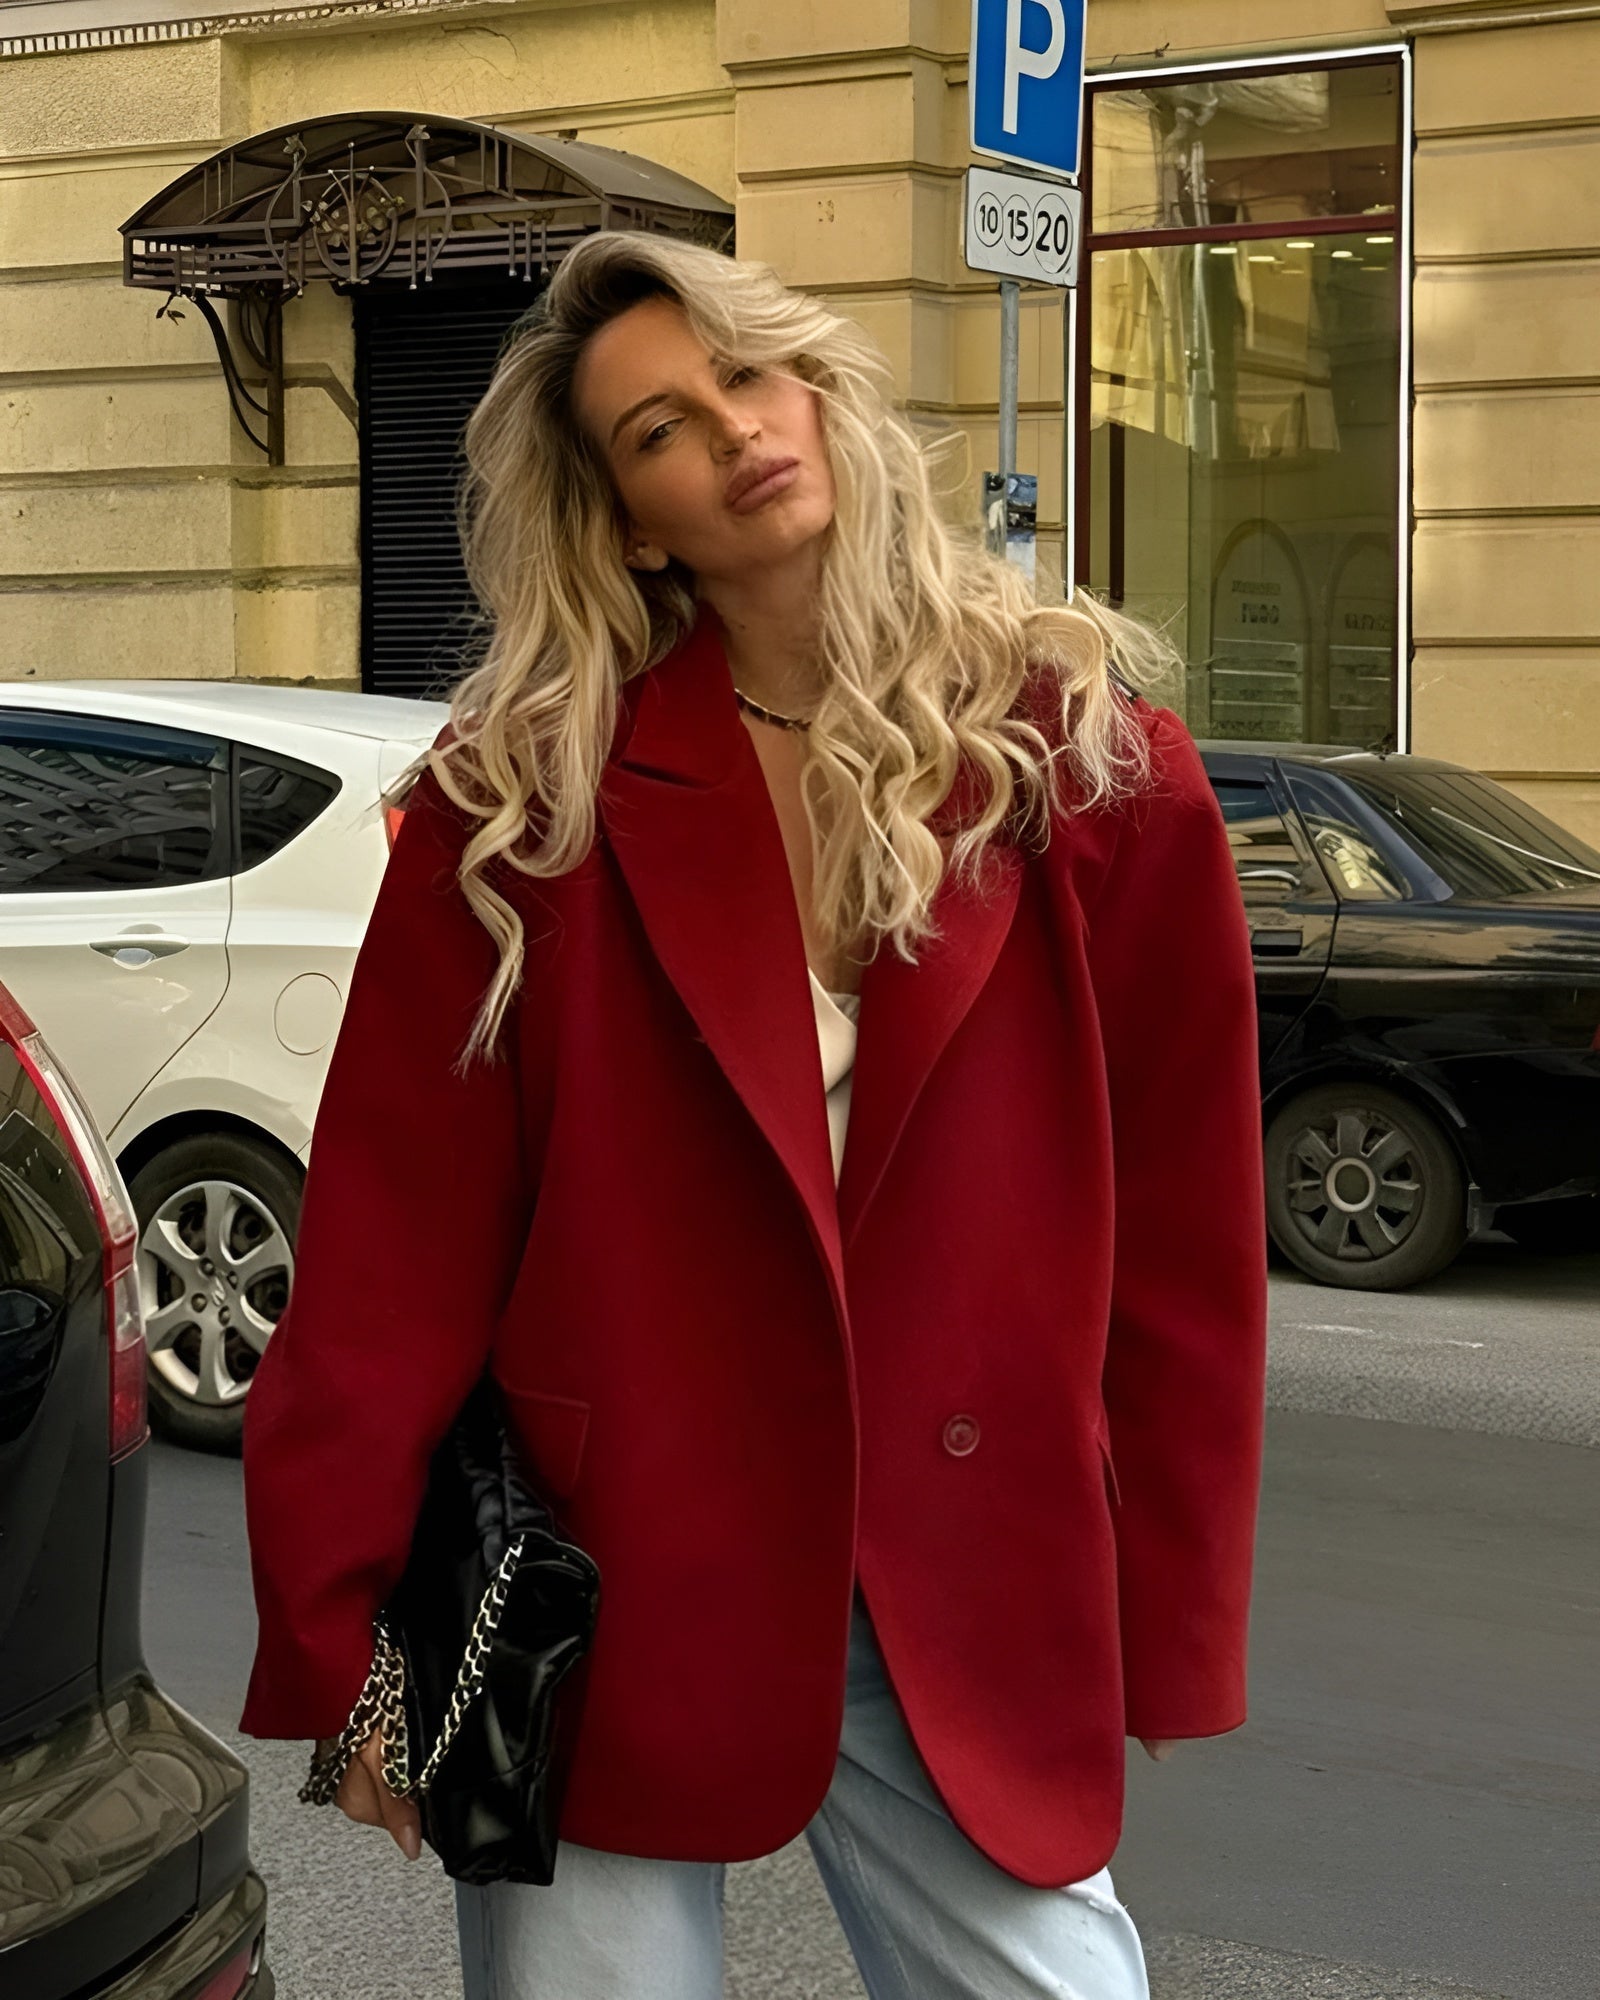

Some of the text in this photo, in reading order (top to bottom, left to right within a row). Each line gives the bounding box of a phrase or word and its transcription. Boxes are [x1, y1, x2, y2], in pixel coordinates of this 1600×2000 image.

[1002, 0, 1066, 135] P
[979, 204, 1069, 256] 10 15 20
